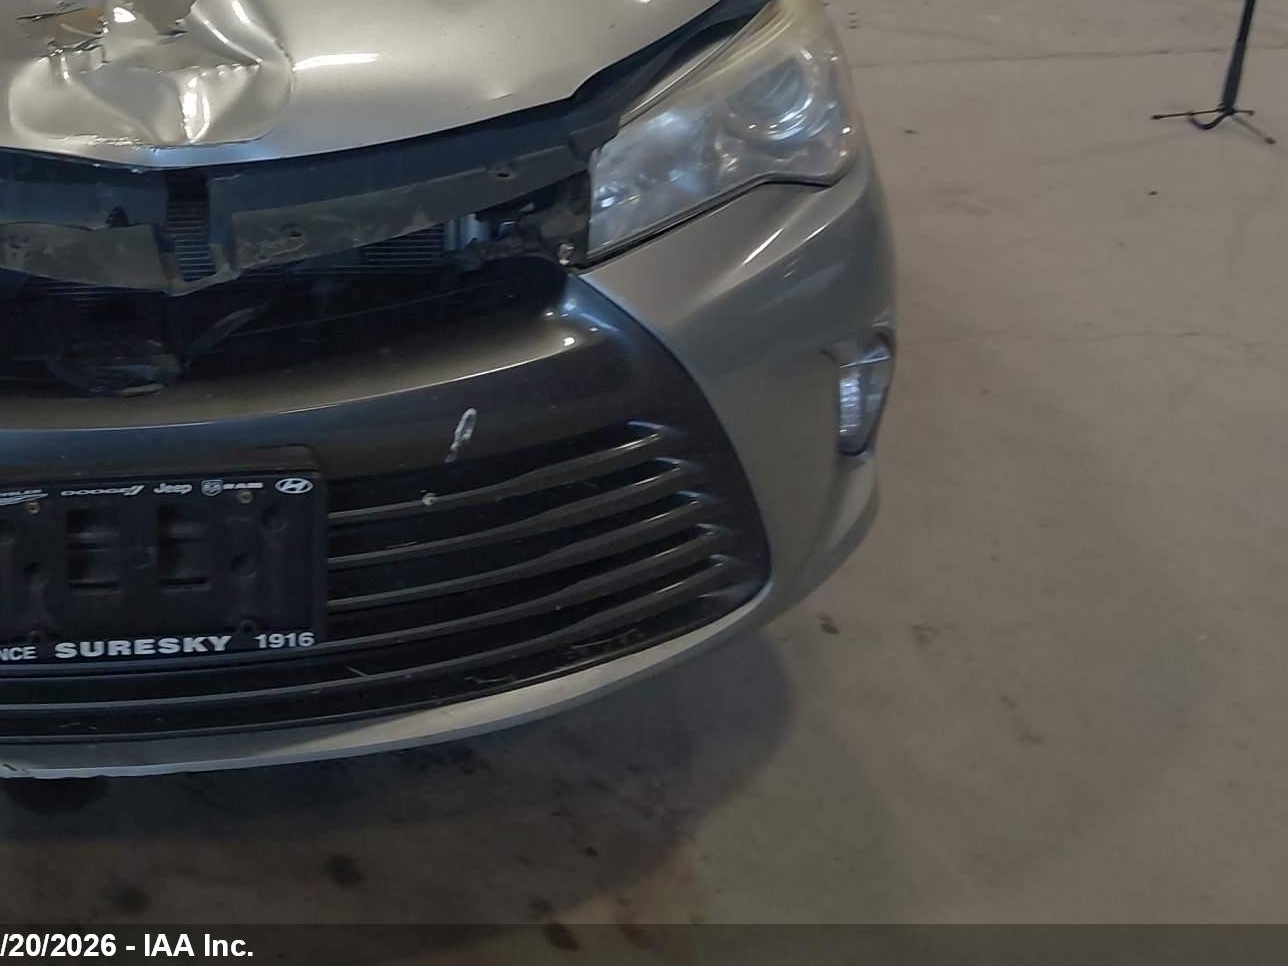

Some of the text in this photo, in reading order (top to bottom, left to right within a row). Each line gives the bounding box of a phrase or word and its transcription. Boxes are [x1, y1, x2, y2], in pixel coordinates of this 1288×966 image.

[153, 483, 193, 495] Jeep
[55, 635, 232, 659] SURESKY
[254, 632, 315, 649] 1916
